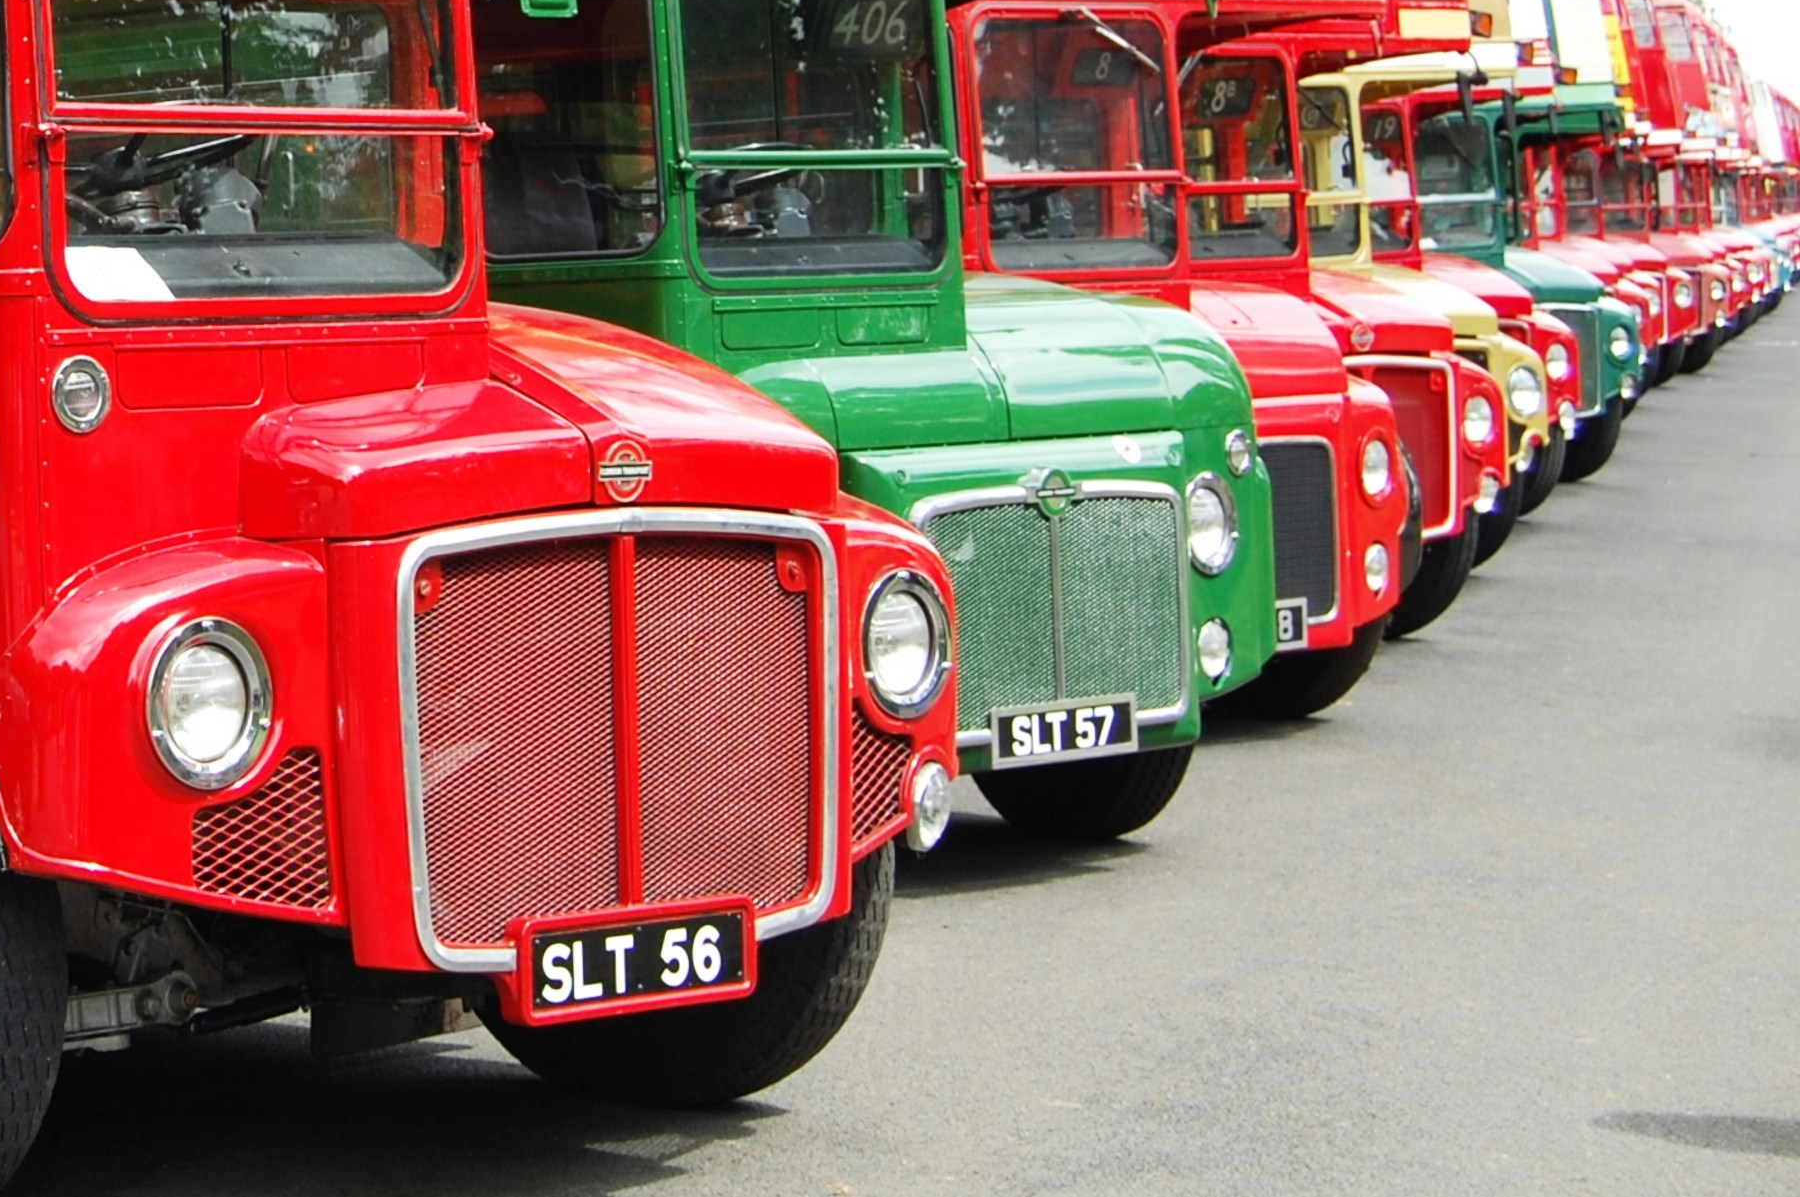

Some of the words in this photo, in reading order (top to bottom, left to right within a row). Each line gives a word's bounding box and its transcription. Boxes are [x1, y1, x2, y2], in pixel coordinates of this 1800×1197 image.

[833, 0, 909, 46] 406
[1096, 52, 1111, 80] 8
[1373, 116, 1397, 140] 19
[1011, 710, 1068, 757] SLT
[1075, 705, 1115, 750] 57
[541, 934, 635, 1004] SLT
[660, 924, 722, 988] 56
